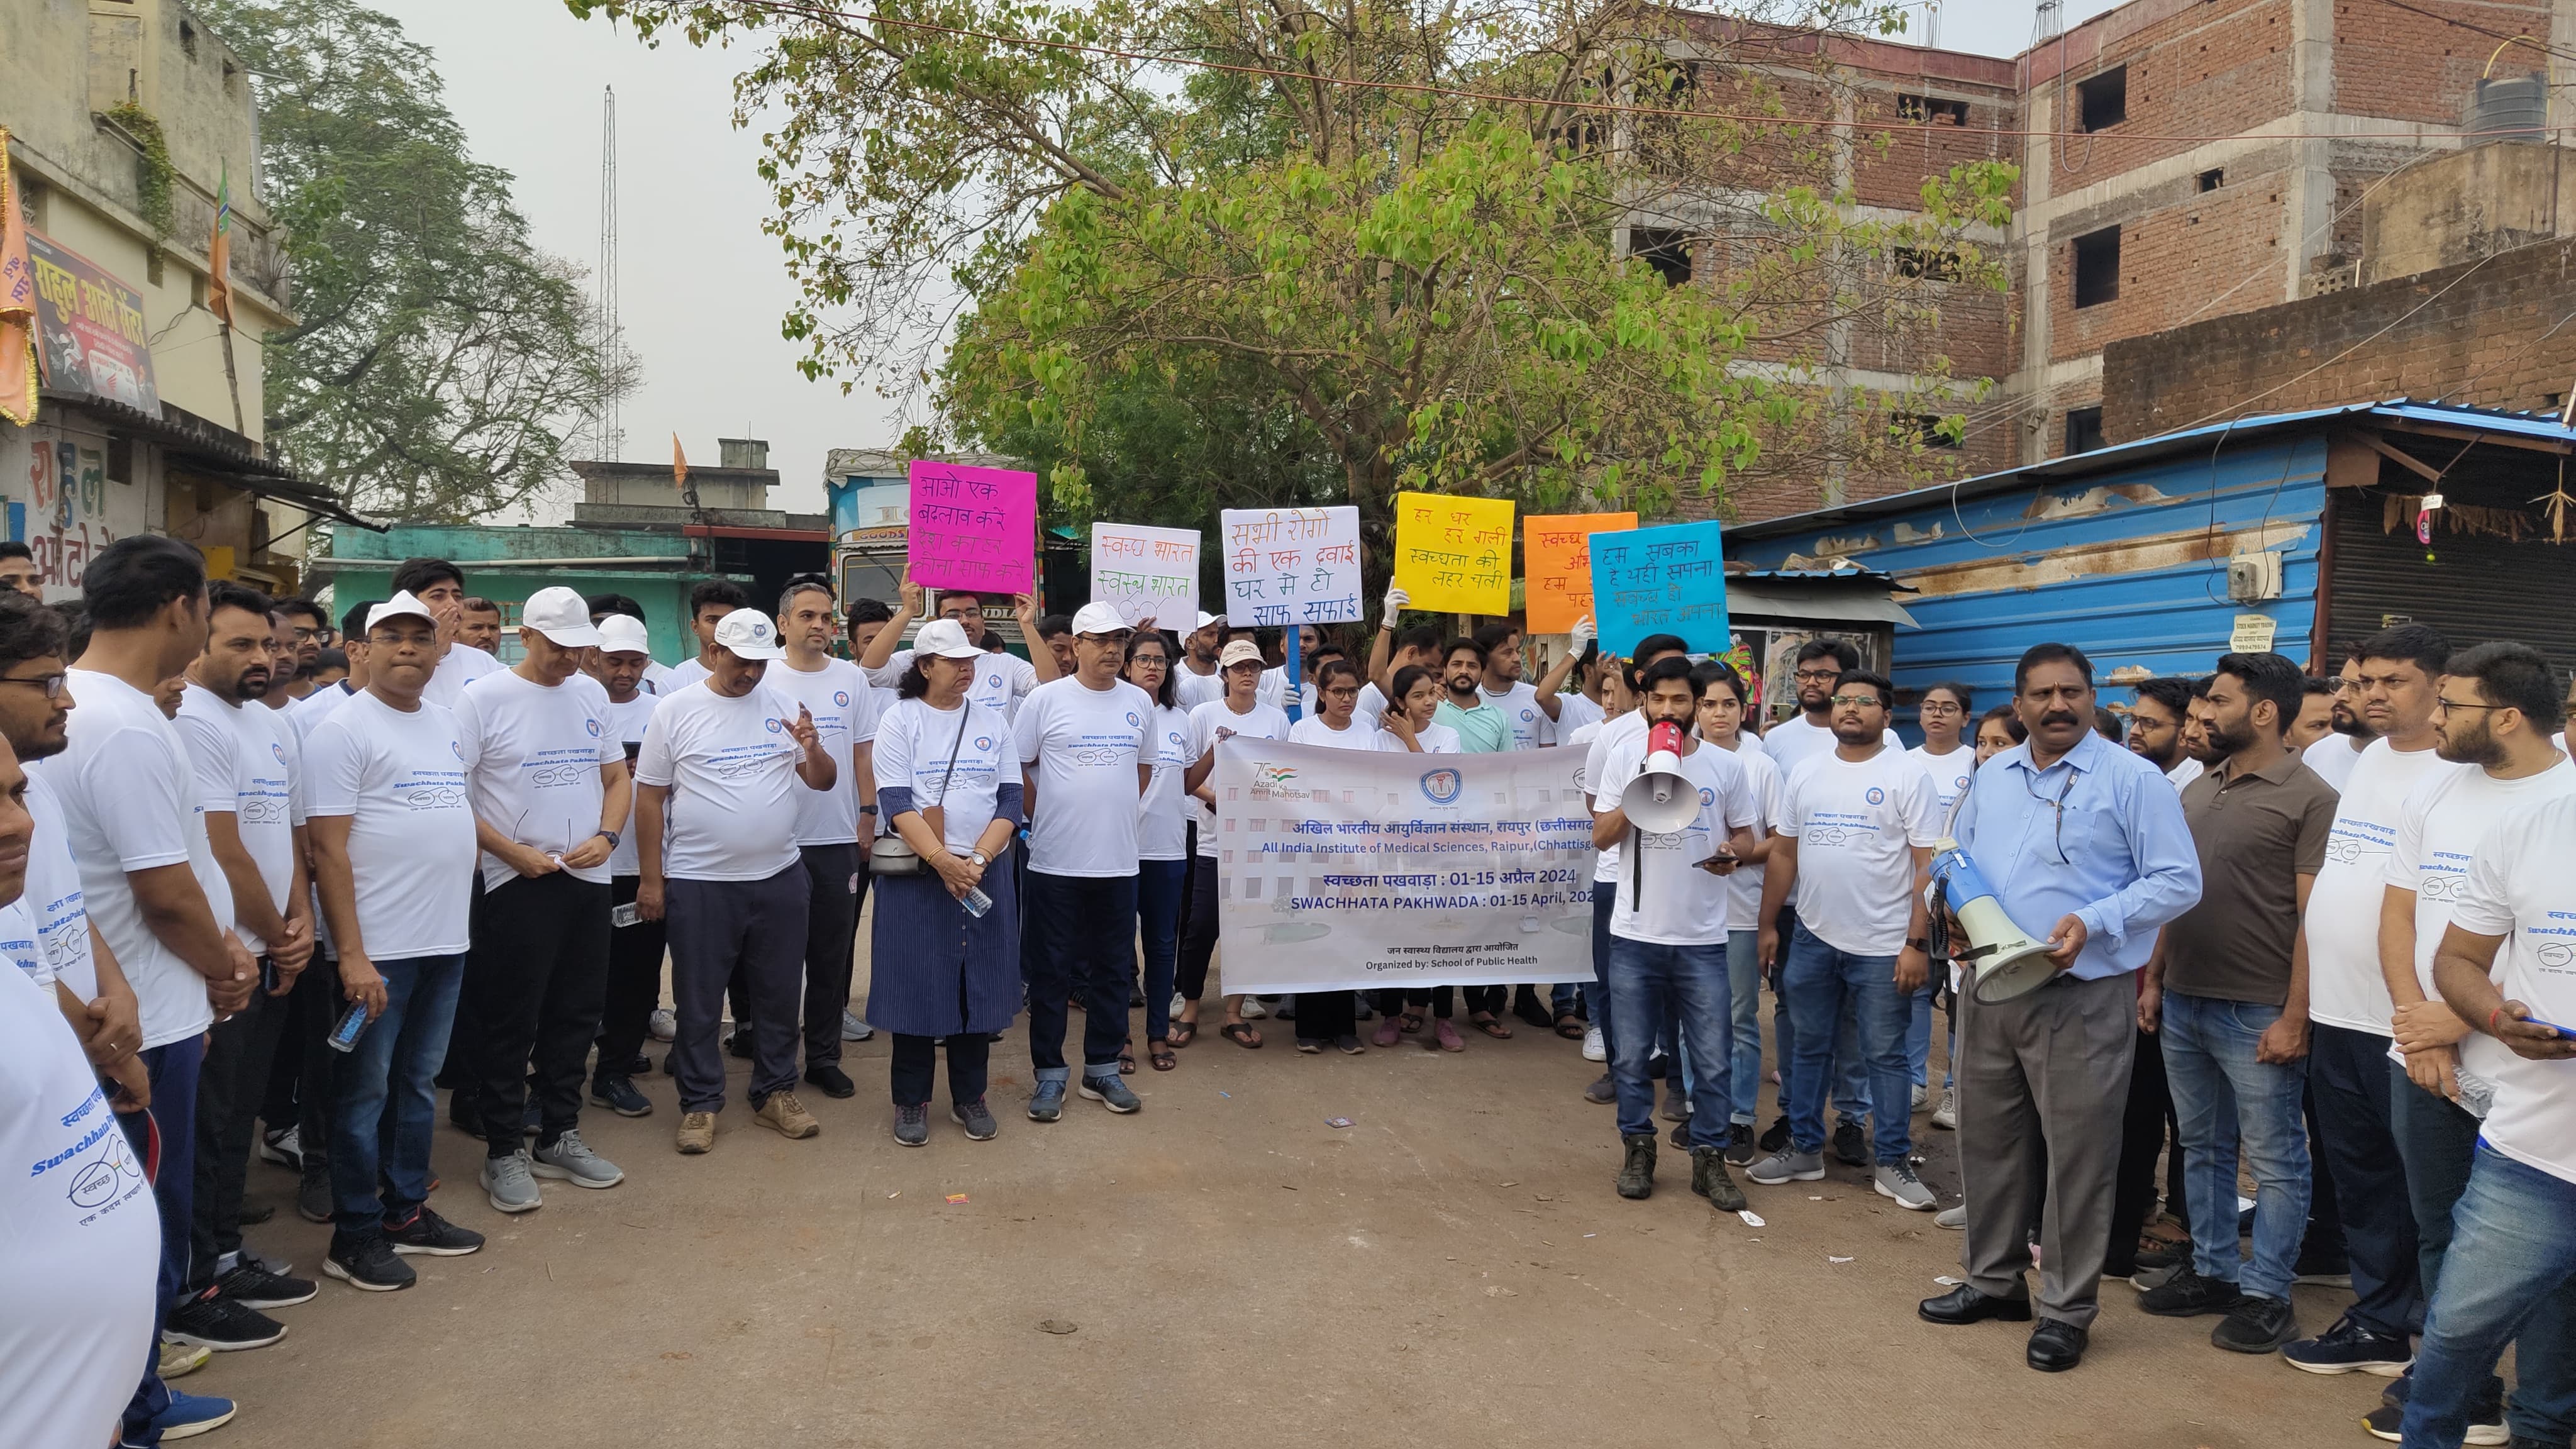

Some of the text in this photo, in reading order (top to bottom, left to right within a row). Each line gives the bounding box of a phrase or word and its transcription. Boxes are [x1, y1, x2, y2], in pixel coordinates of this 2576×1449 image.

[31, 253, 80, 325] राहुल
[30, 440, 105, 530] राहुल
[966, 481, 998, 501] एक
[918, 504, 974, 526] बदलाव
[975, 506, 1006, 531] करें
[1414, 508, 1434, 525] हर
[1231, 512, 1284, 546] सभी
[1444, 526, 1508, 546] हर गली
[950, 535, 981, 553] का
[1154, 541, 1196, 563] भारत
[1602, 540, 1701, 565] हम सबका
[1231, 540, 1355, 574] की एक दवाई
[1476, 549, 1501, 570] की
[1432, 570, 1505, 590] लहर चली
[1667, 560, 1714, 580] सपना
[1151, 575, 1191, 598] भारत
[1231, 579, 1266, 601] घर
[1543, 577, 1568, 591] हम
[983, 608, 1018, 619] NDIA
[1252, 592, 1358, 626] साफ सफाई
[1253, 780, 1277, 788] Azadi
[1272, 790, 1310, 799] Mahotsav
[1292, 817, 1594, 837] अखिल भारतीय आयुर्विज्ञान संस्थान, रायपुर (छत्तीसगढ़
[1262, 842, 1278, 853] All
[1282, 843, 1313, 853] India
[1316, 843, 1367, 853] Institute
[1370, 843, 1381, 853] of
[1384, 842, 1430, 853] Medical
[1433, 841, 1488, 854] Sciences,
[1323, 874, 1379, 887] स्वच्छता
[1382, 874, 1437, 890] पखवाड़ा
[1450, 872, 1494, 886] 01-15
[1499, 868, 1535, 884] अप्रैल
[1539, 869, 1576, 883] 2024
[1291, 897, 1389, 909] SWACHHATA
[1393, 896, 1479, 909] PAKHWADA
[1490, 894, 1527, 906] 01-15
[1531, 892, 1565, 907] April,
[1569, 891, 1594, 902] 202
[1433, 945, 1463, 954] विद्यालय
[1465, 945, 1481, 954] द्वारा
[1484, 941, 1519, 952] आयोजित
[1365, 956, 1538, 971] Organized by: School of Public Health
[31, 1122, 109, 1177] Swachhata
[80, 1174, 110, 1195] स्वच्छ
[79, 1213, 96, 1226] एक
[99, 1199, 121, 1215] कदम
